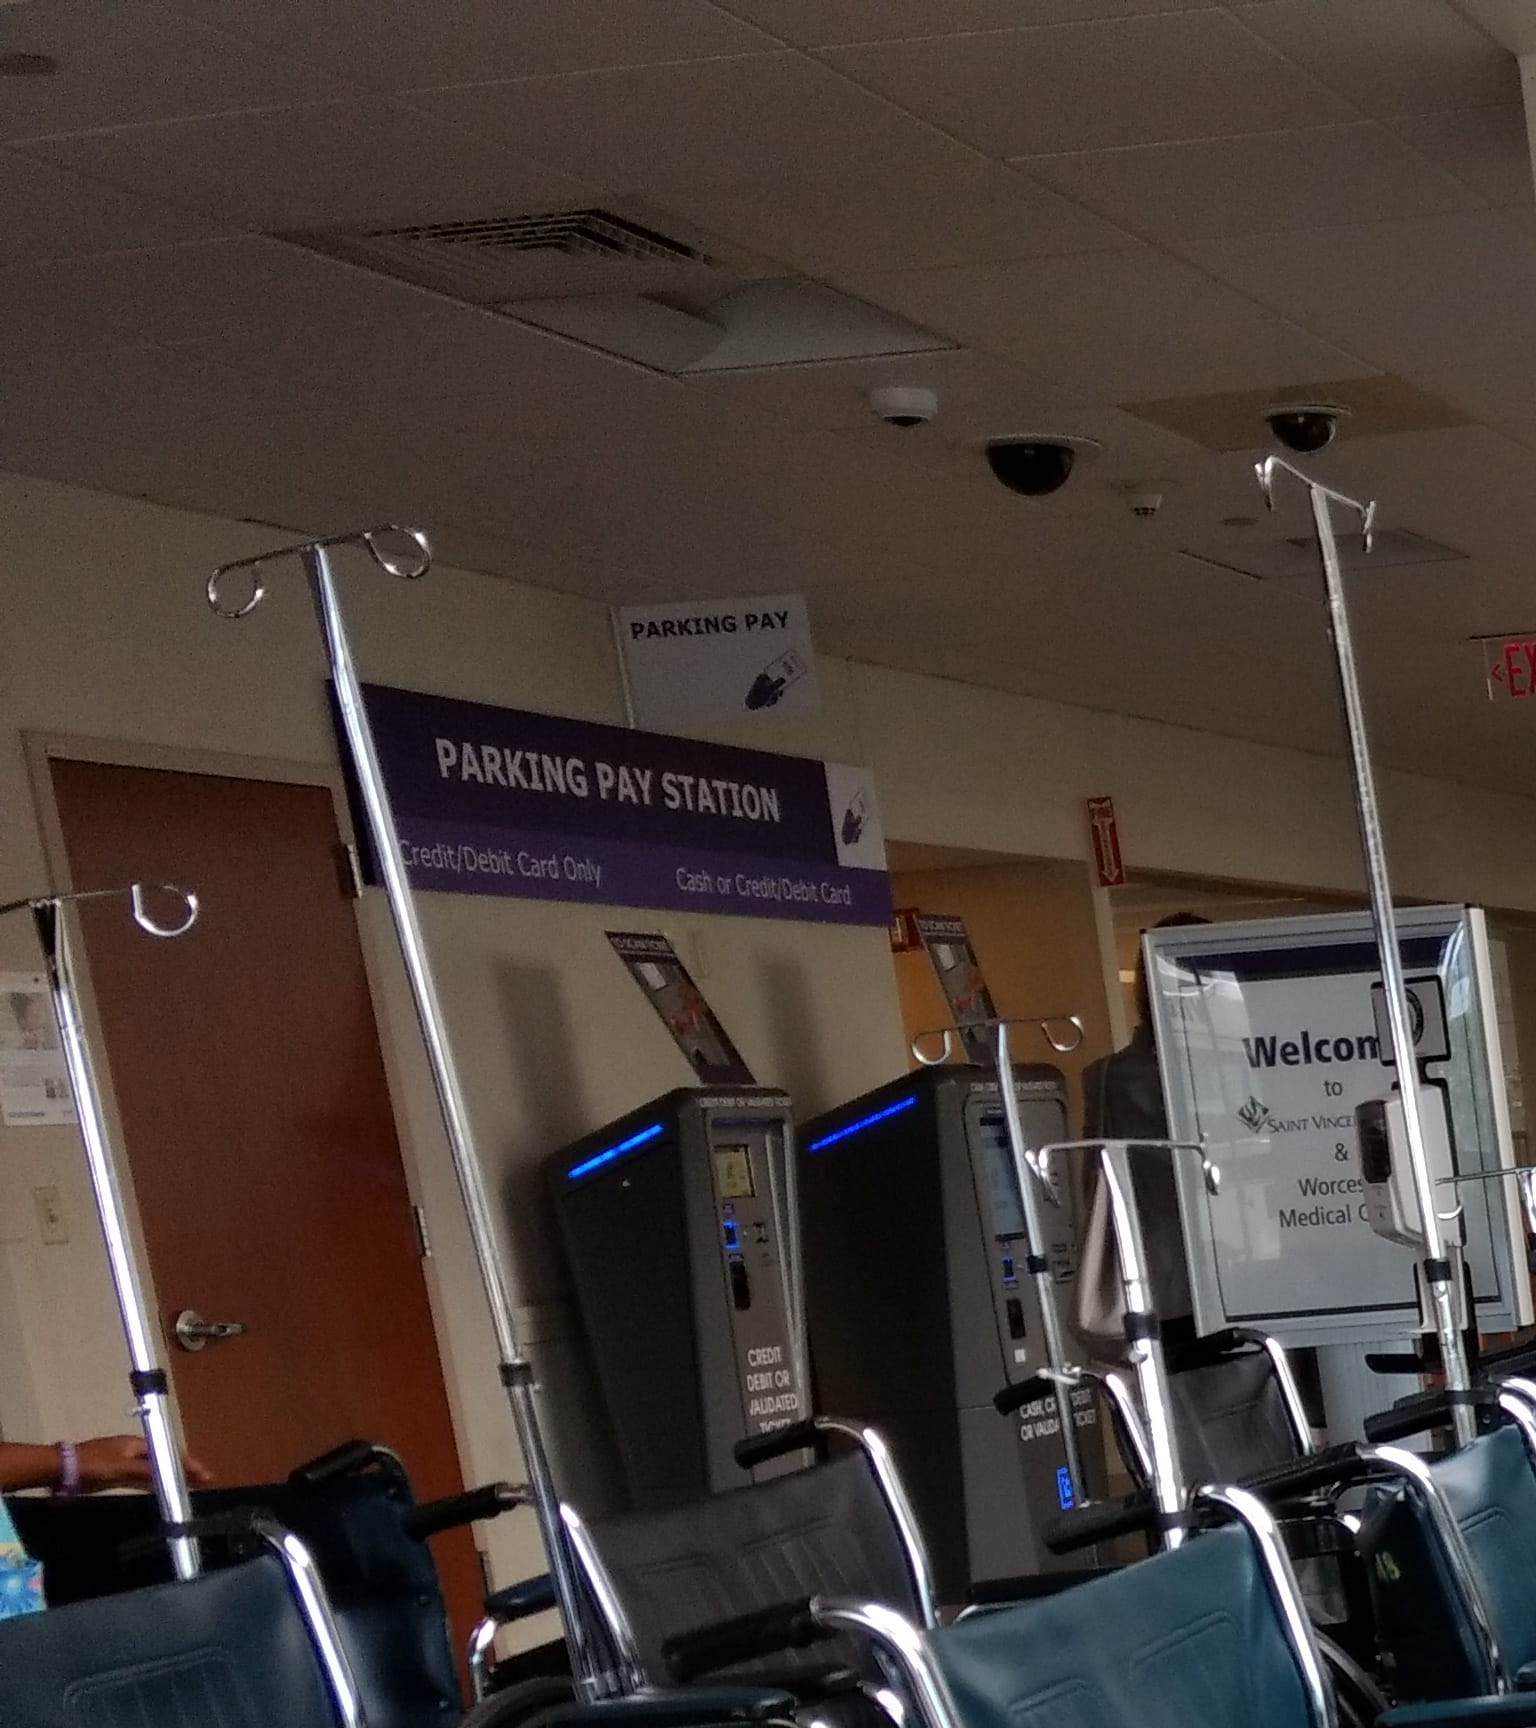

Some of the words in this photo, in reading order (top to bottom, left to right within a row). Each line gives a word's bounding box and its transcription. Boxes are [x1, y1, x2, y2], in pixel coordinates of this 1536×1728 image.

[631, 616, 737, 640] PARKING
[745, 611, 790, 630] PAY
[435, 737, 588, 799] PARKING
[595, 762, 651, 804] PAY
[661, 772, 781, 823] STATION
[401, 842, 512, 877] Credit/Debit
[517, 851, 559, 880] Card
[564, 855, 601, 889] Only
[676, 867, 713, 893] Cash
[718, 877, 732, 895] or
[736, 873, 818, 905] Credit/Debit
[821, 882, 852, 906] Card
[1323, 1080, 1344, 1096] to
[1311, 1114, 1355, 1129] VINCE
[1335, 1142, 1349, 1162] &
[1298, 1177, 1364, 1197] Worces
[1279, 1203, 1351, 1228] Medical
[747, 1346, 782, 1367] CREDIT
[746, 1372, 773, 1392] DEBIT
[775, 1369, 790, 1387] OR
